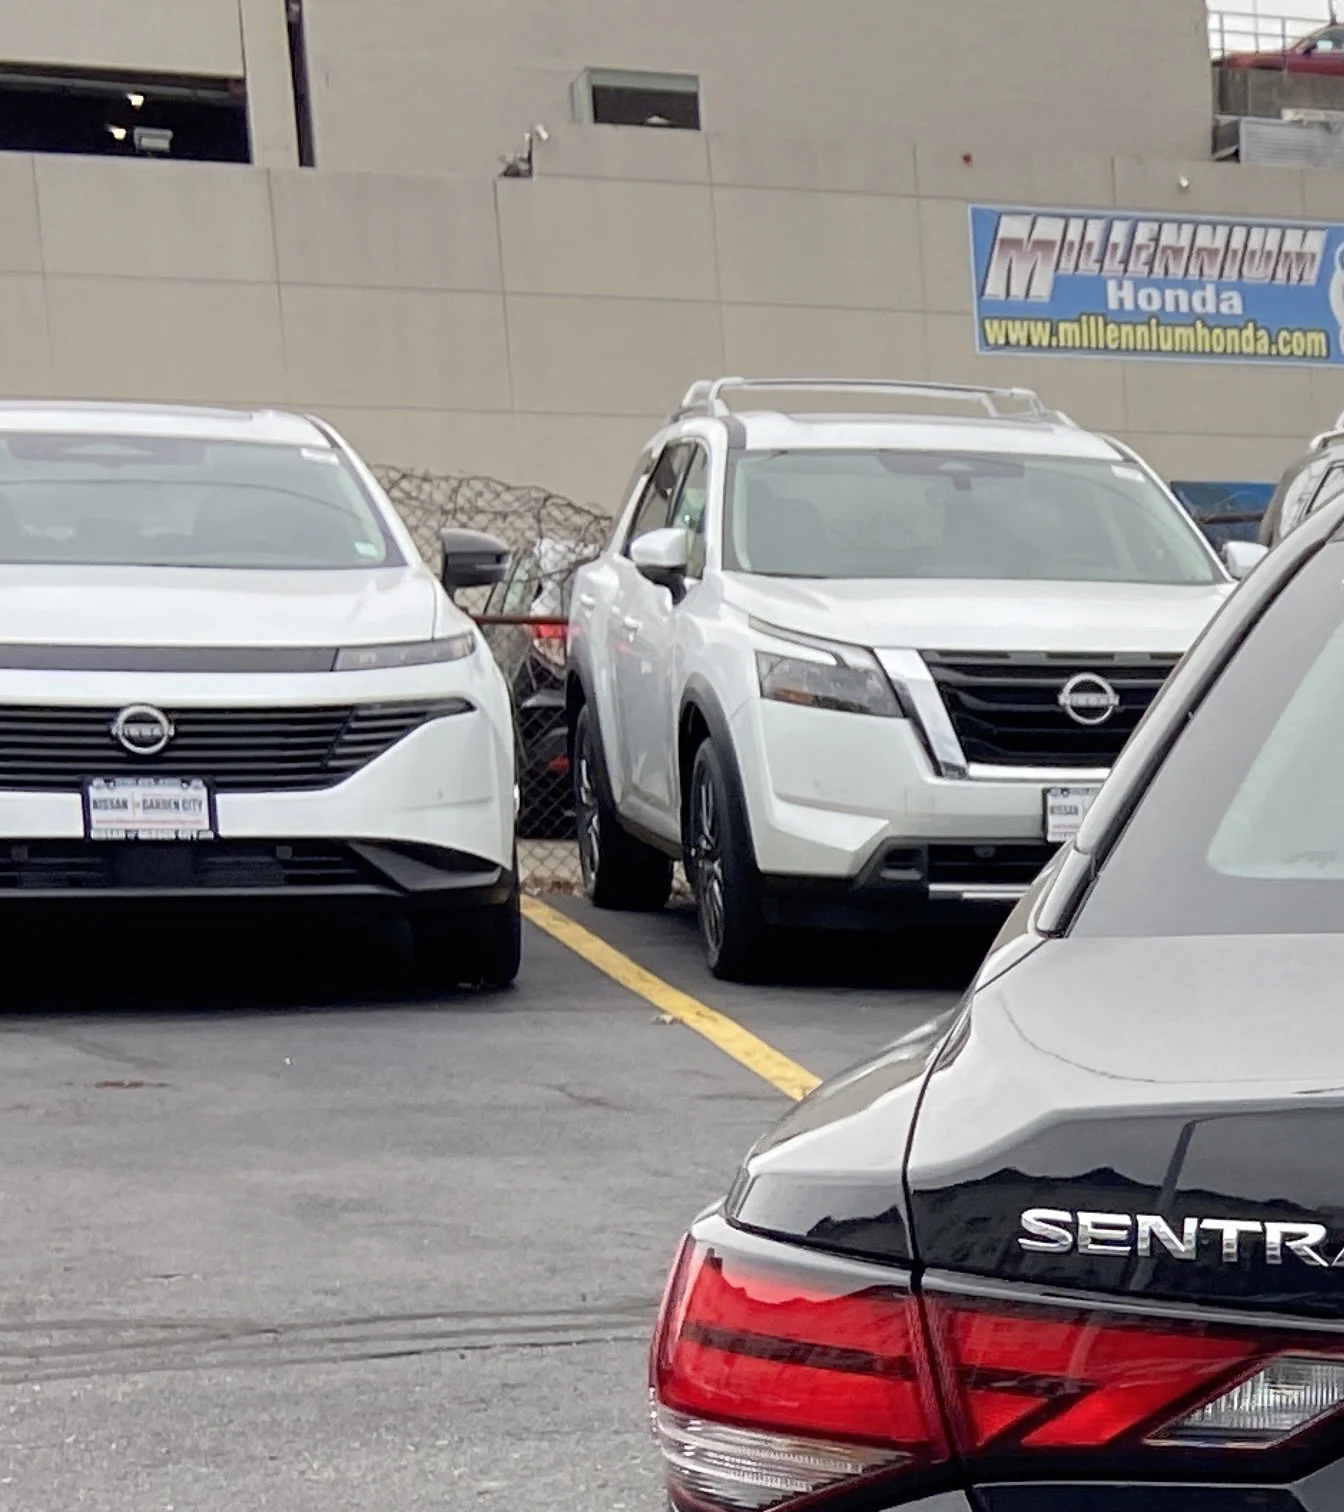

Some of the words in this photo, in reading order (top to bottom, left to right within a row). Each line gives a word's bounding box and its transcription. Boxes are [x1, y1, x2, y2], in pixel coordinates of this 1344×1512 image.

[981, 212, 1329, 302] MILLENNIUM
[1106, 279, 1243, 315] Honda
[983, 313, 1329, 359] www.millenniumhonda.com
